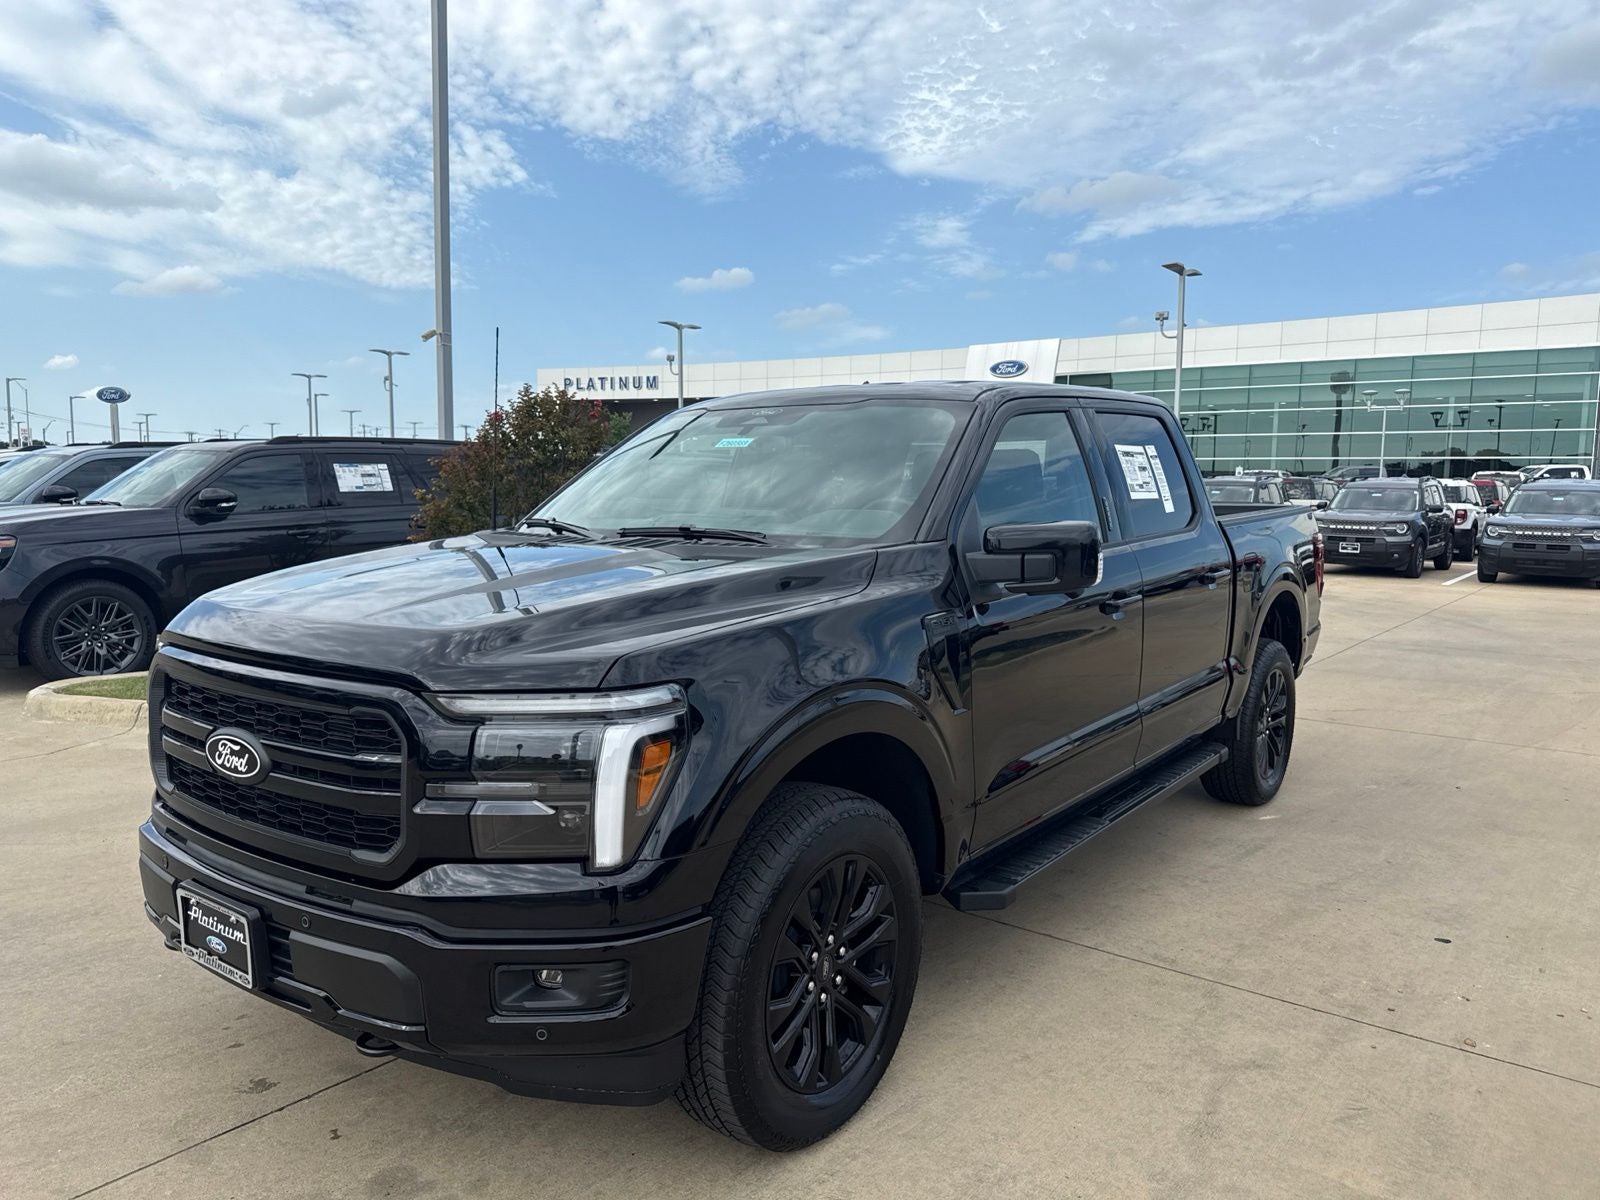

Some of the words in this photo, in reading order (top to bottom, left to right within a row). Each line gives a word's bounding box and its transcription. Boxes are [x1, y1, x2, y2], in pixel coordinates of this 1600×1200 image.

[996, 363, 1018, 373] Ford
[102, 389, 121, 400] Ford
[564, 375, 659, 391] PLATINUM
[215, 740, 249, 773] Ford
[188, 905, 247, 945] Platinum
[197, 949, 236, 979] Platinum
